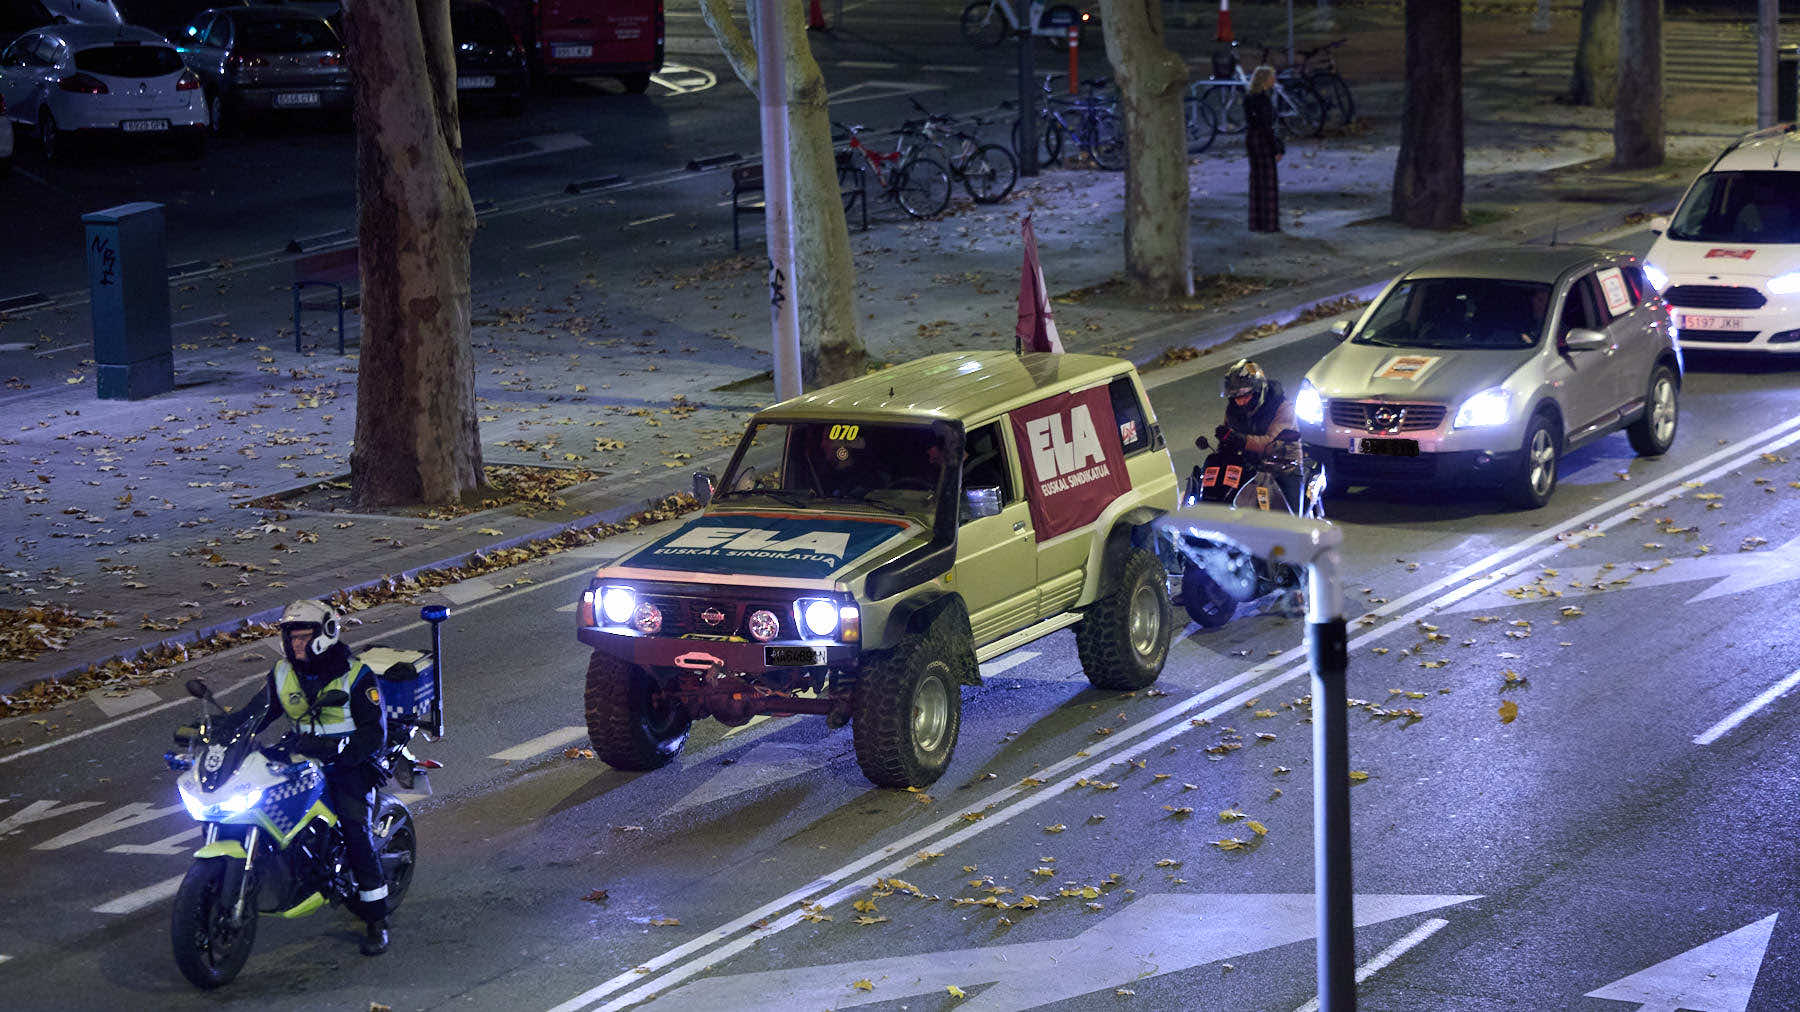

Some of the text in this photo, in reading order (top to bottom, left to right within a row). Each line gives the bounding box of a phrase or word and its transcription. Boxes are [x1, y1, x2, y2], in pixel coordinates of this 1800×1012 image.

[1687, 317, 1714, 329] 5197
[829, 424, 859, 440] 070
[1026, 404, 1106, 482] ELA
[1040, 463, 1110, 497] EUSKAL SINDIKATUA
[664, 526, 851, 560] ELA
[653, 548, 836, 568] EUSKAL SINDIKATUA
